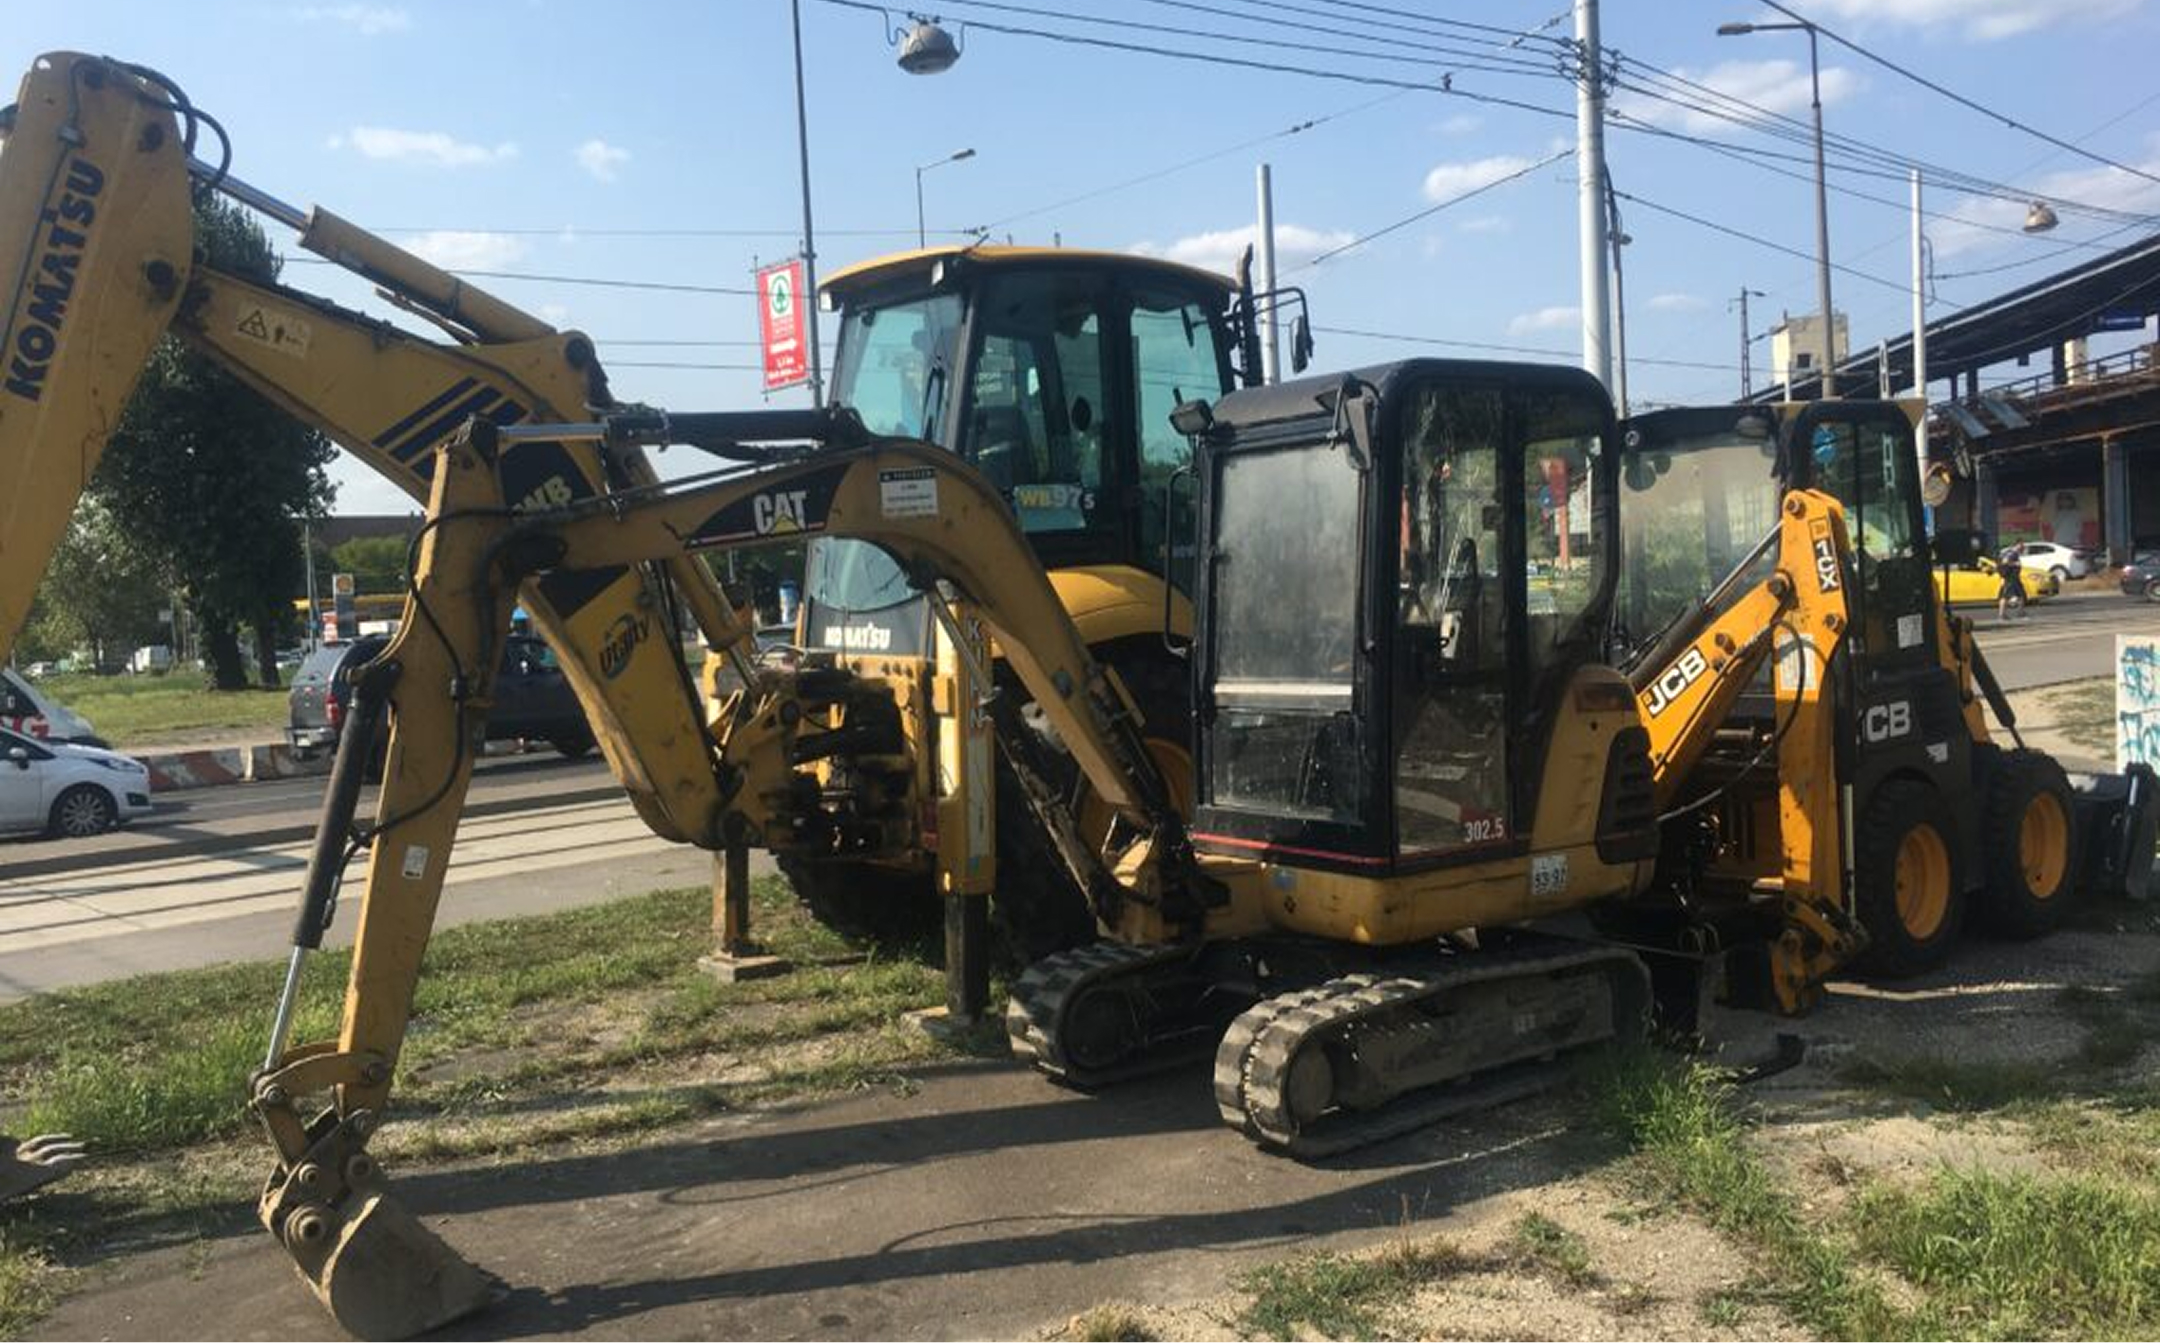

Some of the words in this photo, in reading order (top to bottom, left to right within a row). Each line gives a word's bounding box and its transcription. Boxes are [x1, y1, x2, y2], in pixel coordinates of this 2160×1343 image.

[5, 157, 105, 402] KOMATSU
[753, 490, 808, 535] CAT
[1816, 539, 1839, 590] 1CX
[1647, 648, 1707, 716] JCB
[1857, 700, 1911, 742] CB
[1464, 817, 1505, 843] 302.5
